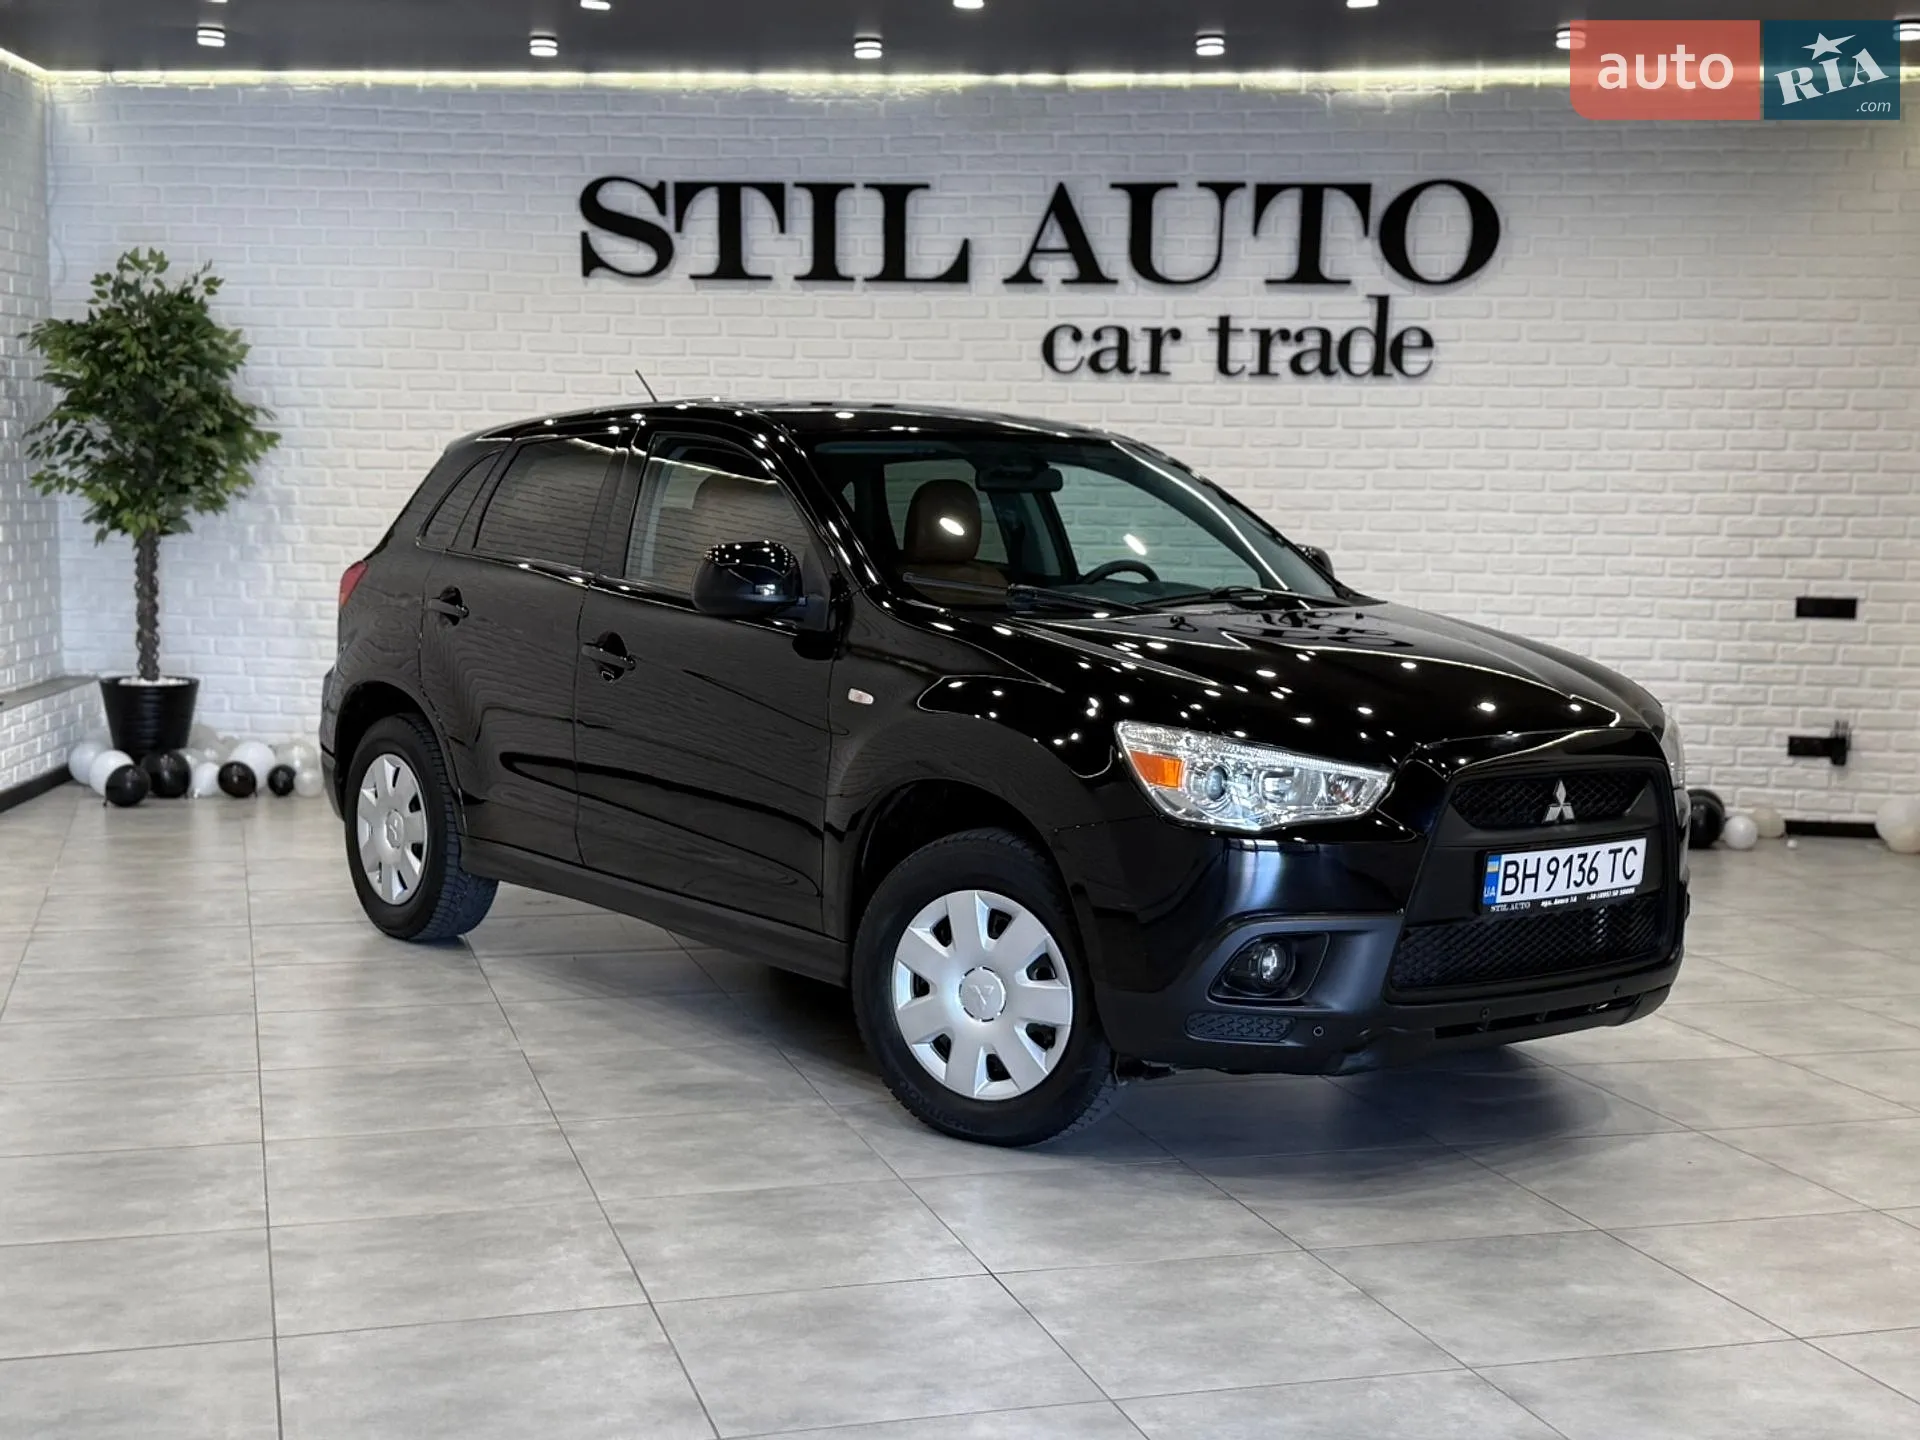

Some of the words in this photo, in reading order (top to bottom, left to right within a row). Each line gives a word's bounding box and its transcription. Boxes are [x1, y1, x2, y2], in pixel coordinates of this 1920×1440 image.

[579, 175, 970, 285] STIL
[1003, 178, 1501, 286] AUTO
[1042, 324, 1181, 373] car
[1208, 295, 1434, 377] trade
[1483, 885, 1496, 898] UA
[1501, 857, 1541, 897] BH
[1545, 850, 1601, 892] 9136
[1608, 846, 1638, 883] TC
